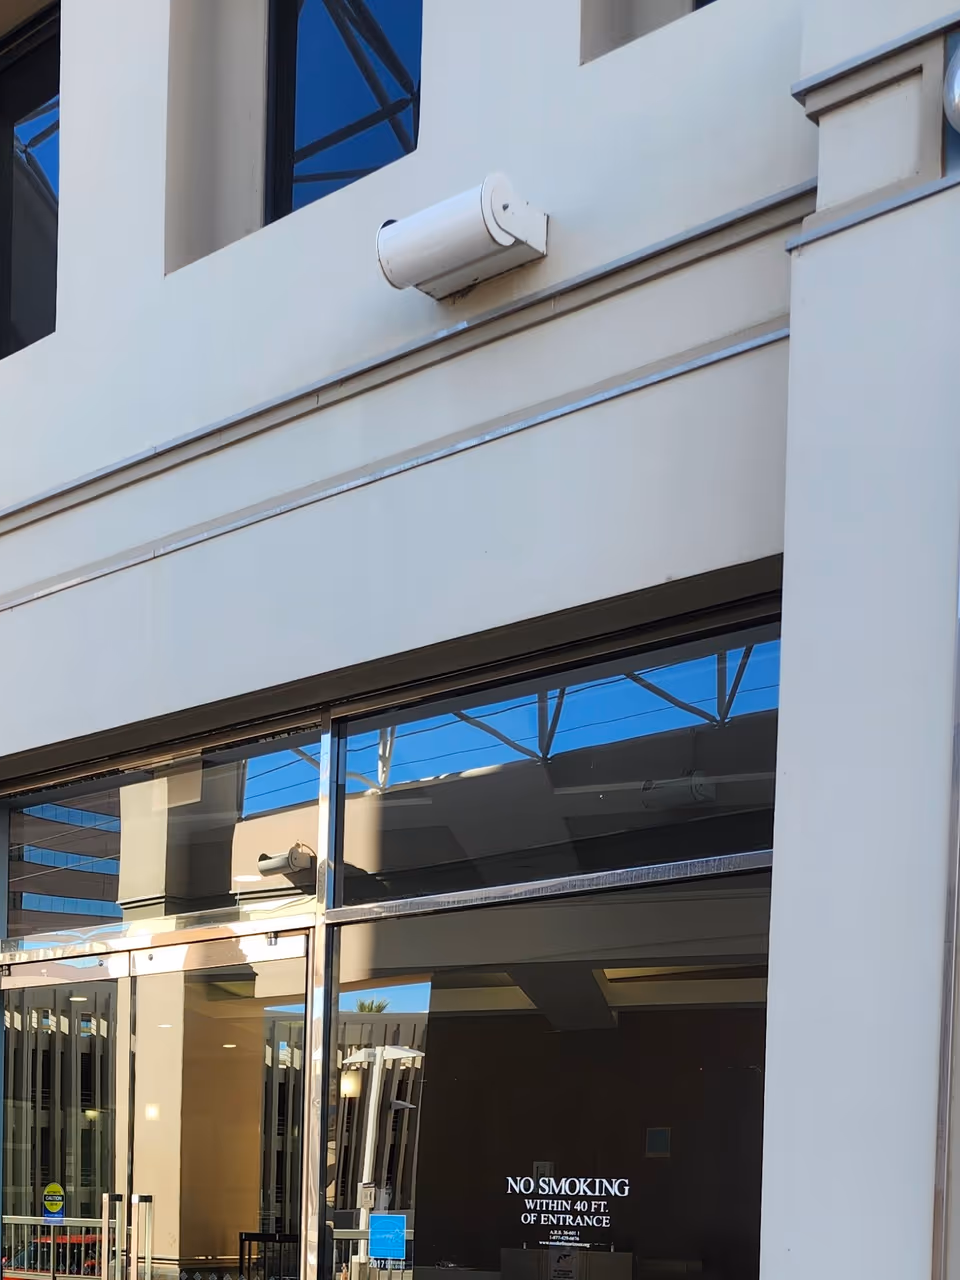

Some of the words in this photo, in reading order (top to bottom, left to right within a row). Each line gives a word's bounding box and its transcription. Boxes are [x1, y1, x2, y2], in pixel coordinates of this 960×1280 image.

[506, 1176, 534, 1194] NO
[538, 1177, 630, 1197] SMOKING
[524, 1199, 571, 1211] WITHIN
[574, 1200, 588, 1212] 40
[591, 1201, 609, 1213] FT.
[521, 1213, 538, 1224] OF
[540, 1213, 611, 1227] ENTRANCE
[369, 1259, 385, 1268] 2017
